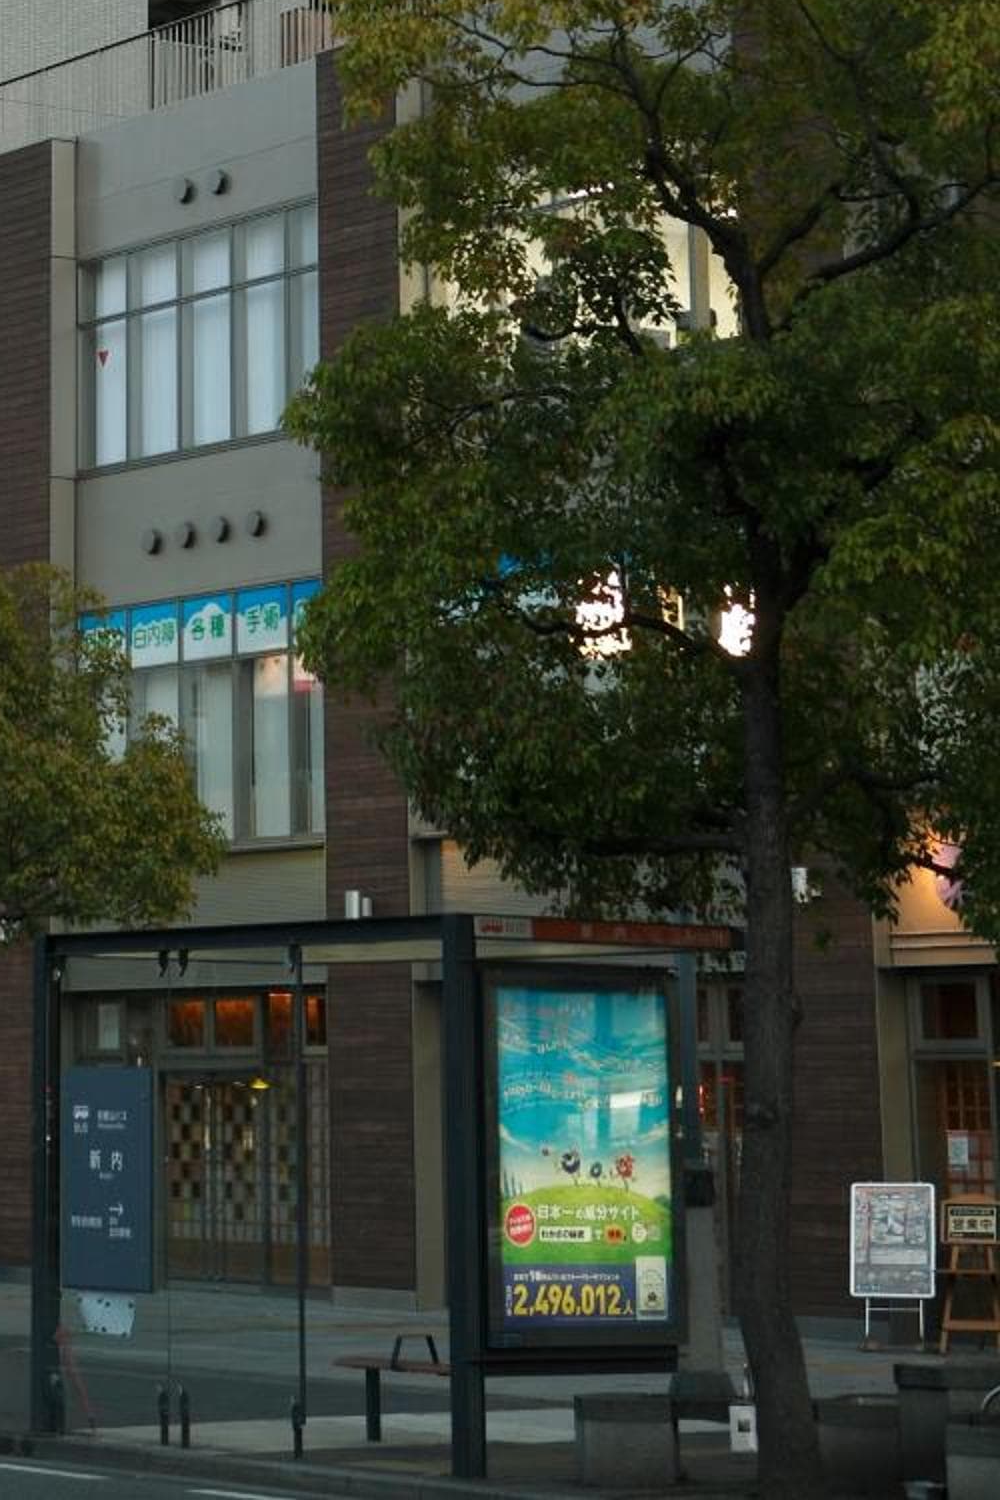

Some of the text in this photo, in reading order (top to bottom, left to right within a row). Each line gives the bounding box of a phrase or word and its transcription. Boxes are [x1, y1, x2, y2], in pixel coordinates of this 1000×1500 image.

[134, 620, 177, 650] 白内障
[192, 615, 225, 641] 各種
[246, 603, 281, 635] 手術
[952, 1218, 993, 1231] 営業中
